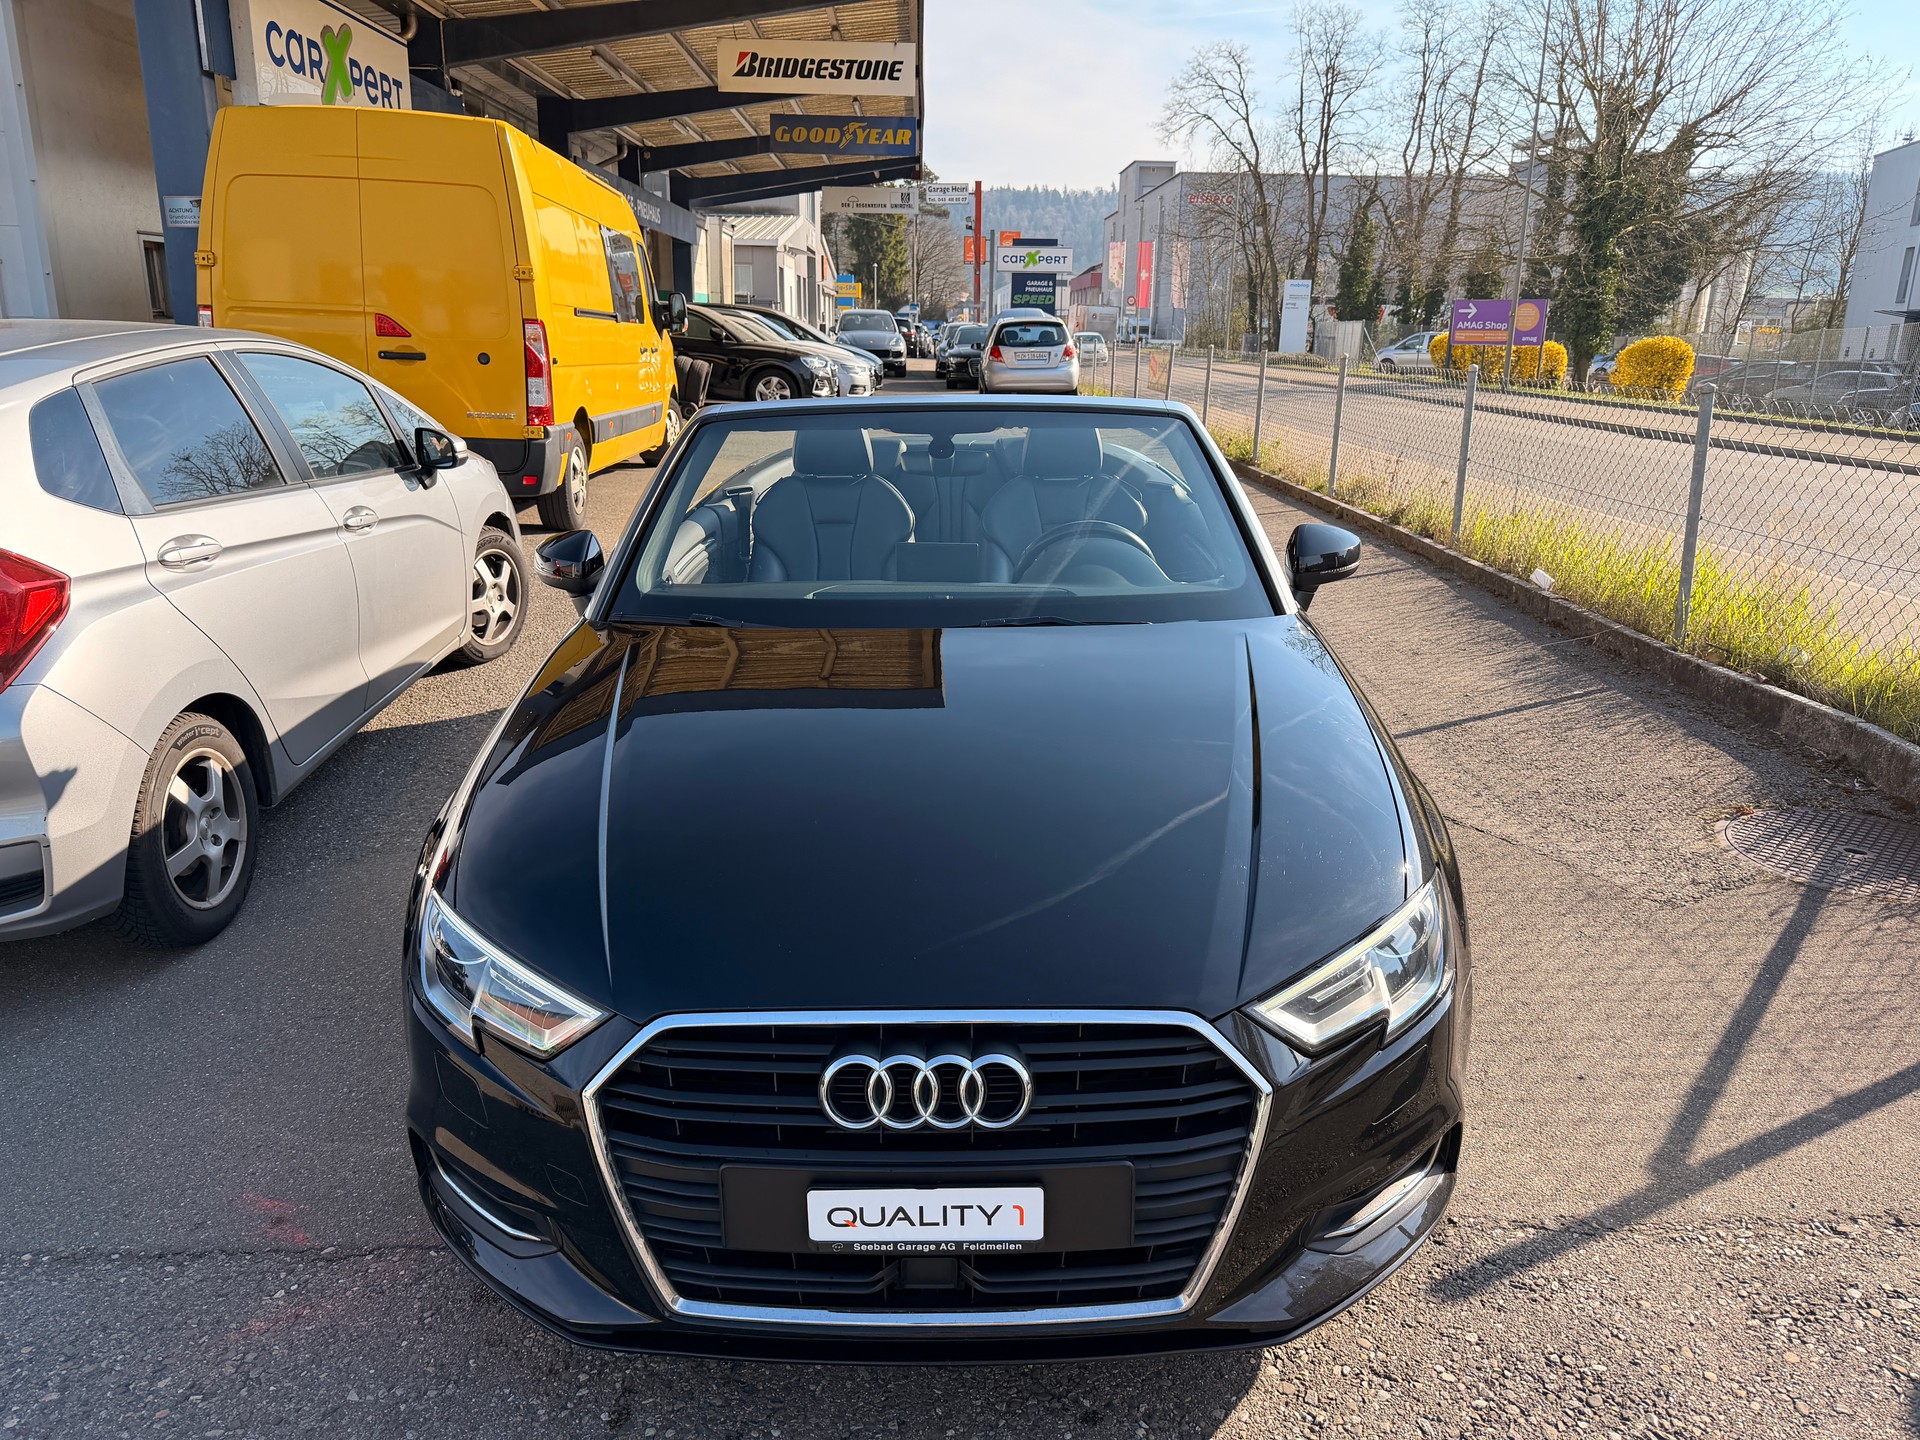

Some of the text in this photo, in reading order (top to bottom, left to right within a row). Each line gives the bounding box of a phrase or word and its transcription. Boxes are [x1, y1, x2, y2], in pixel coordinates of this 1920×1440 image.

[732, 51, 904, 81] BRIDGESTONE
[774, 123, 911, 147] GOODYEAR
[928, 185, 968, 194] Garage Heiri
[1189, 190, 1234, 205] eisberg
[637, 199, 661, 225] PNEUHAUS
[1012, 294, 1055, 304] SPEED
[1457, 321, 1508, 330] AMAG Shop
[827, 1204, 1024, 1227] QUALITY 1
[853, 1242, 894, 1250] Seebad
[897, 1243, 936, 1251] Garage
[963, 1242, 1022, 1250] Feldmeilen
